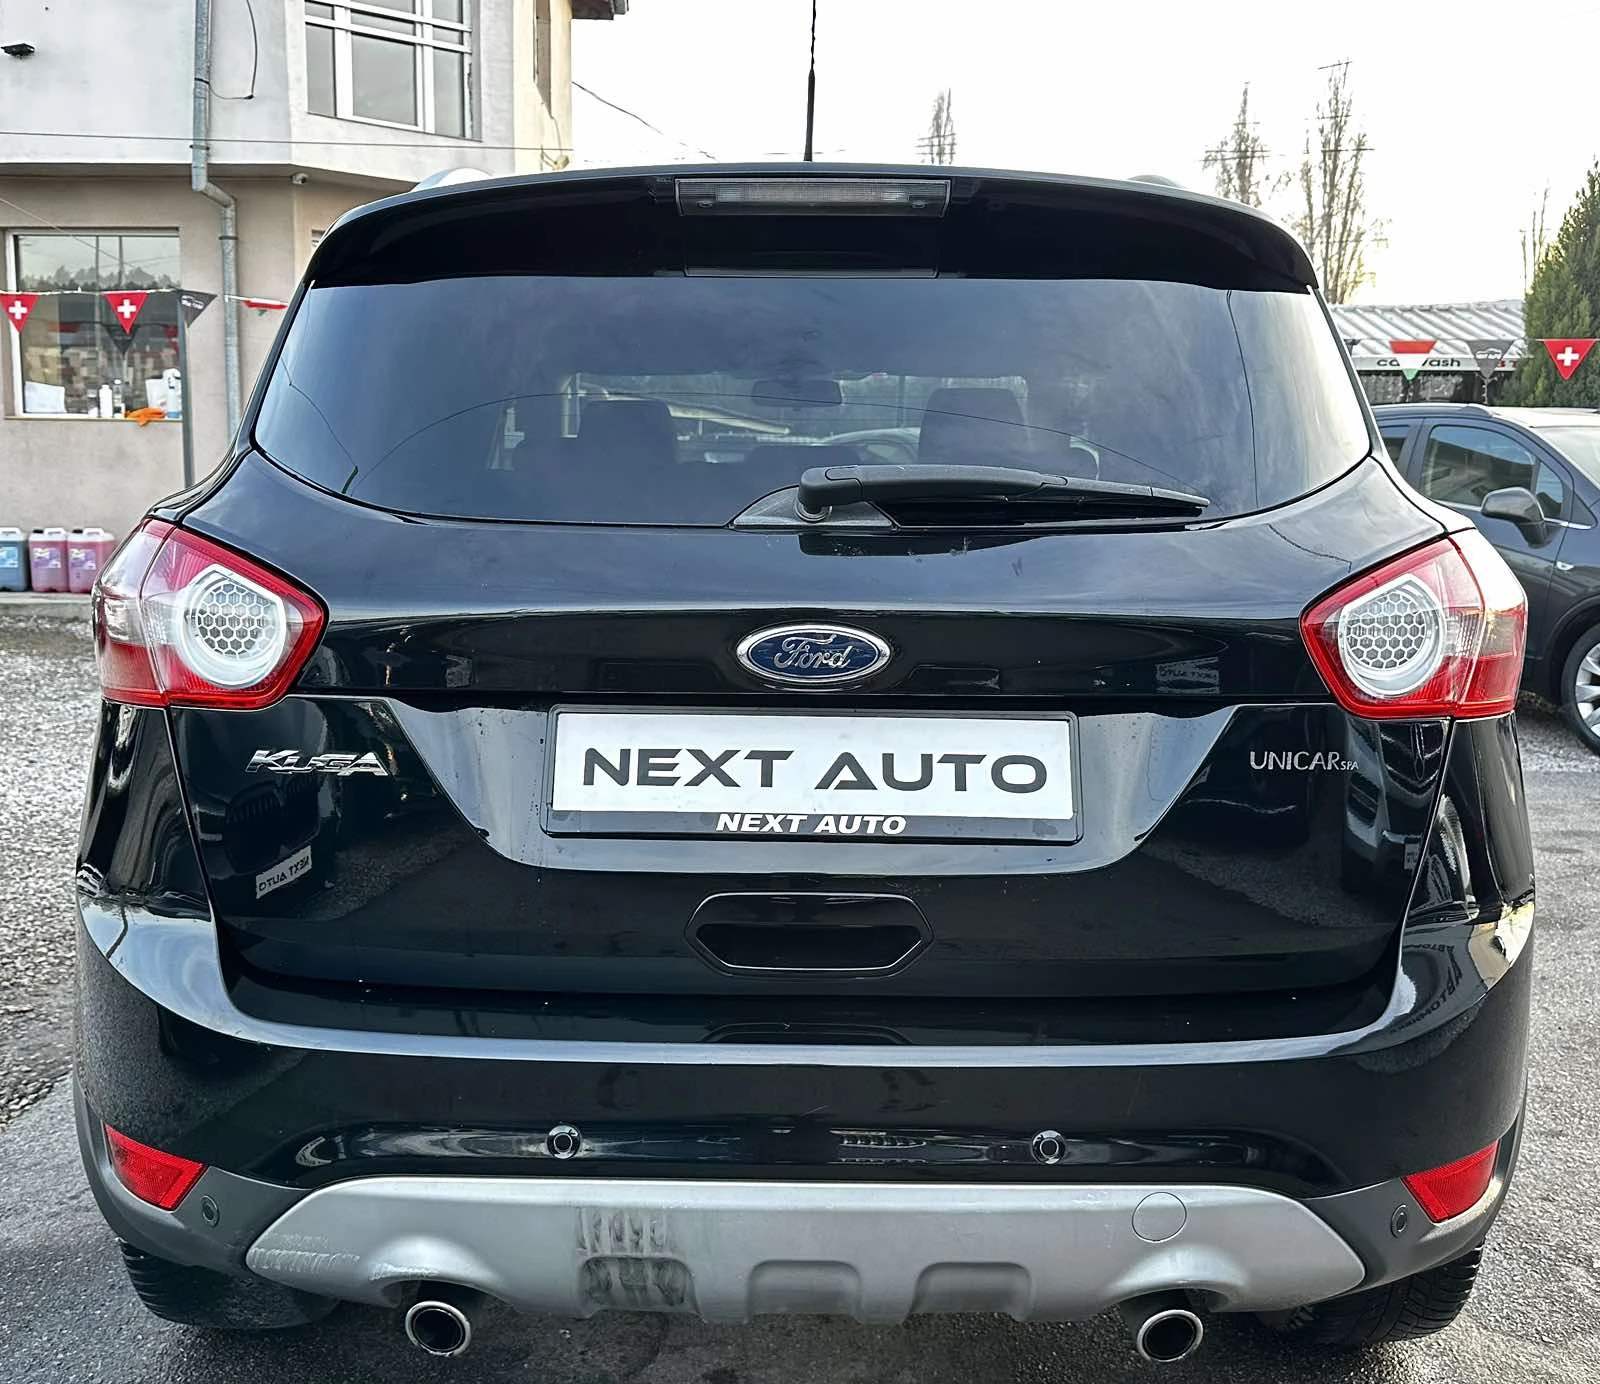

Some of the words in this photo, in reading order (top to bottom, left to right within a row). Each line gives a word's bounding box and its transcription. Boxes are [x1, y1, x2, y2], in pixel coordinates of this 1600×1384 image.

[1376, 358, 1400, 367] ca
[773, 634, 851, 669] Ford
[582, 747, 794, 787] NEXT
[814, 751, 1048, 793] AUTO
[1249, 751, 1340, 770] UNICAR
[715, 813, 808, 833] NEXT
[813, 814, 907, 834] AUTO
